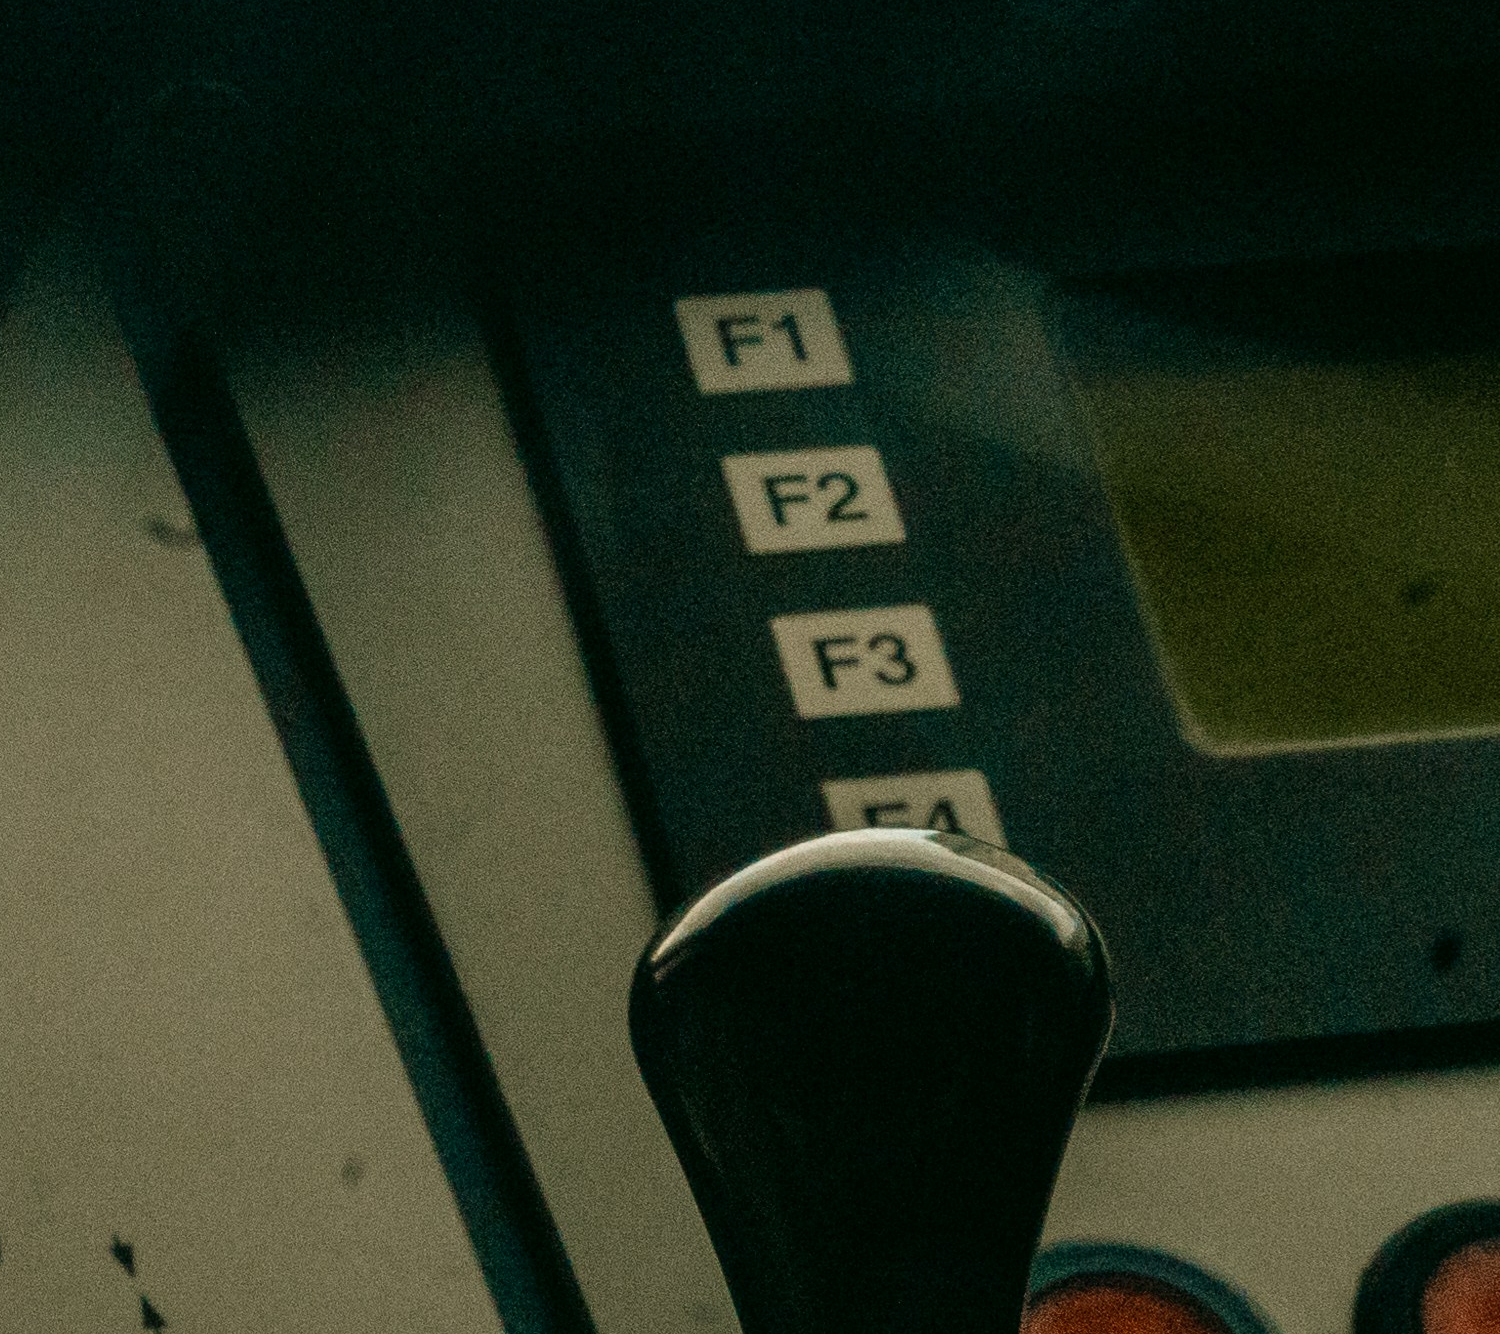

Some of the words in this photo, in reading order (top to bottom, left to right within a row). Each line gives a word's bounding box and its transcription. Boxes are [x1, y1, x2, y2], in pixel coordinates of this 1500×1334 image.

[714, 314, 809, 366] F1
[764, 473, 868, 526] F2
[813, 634, 917, 687] F3
